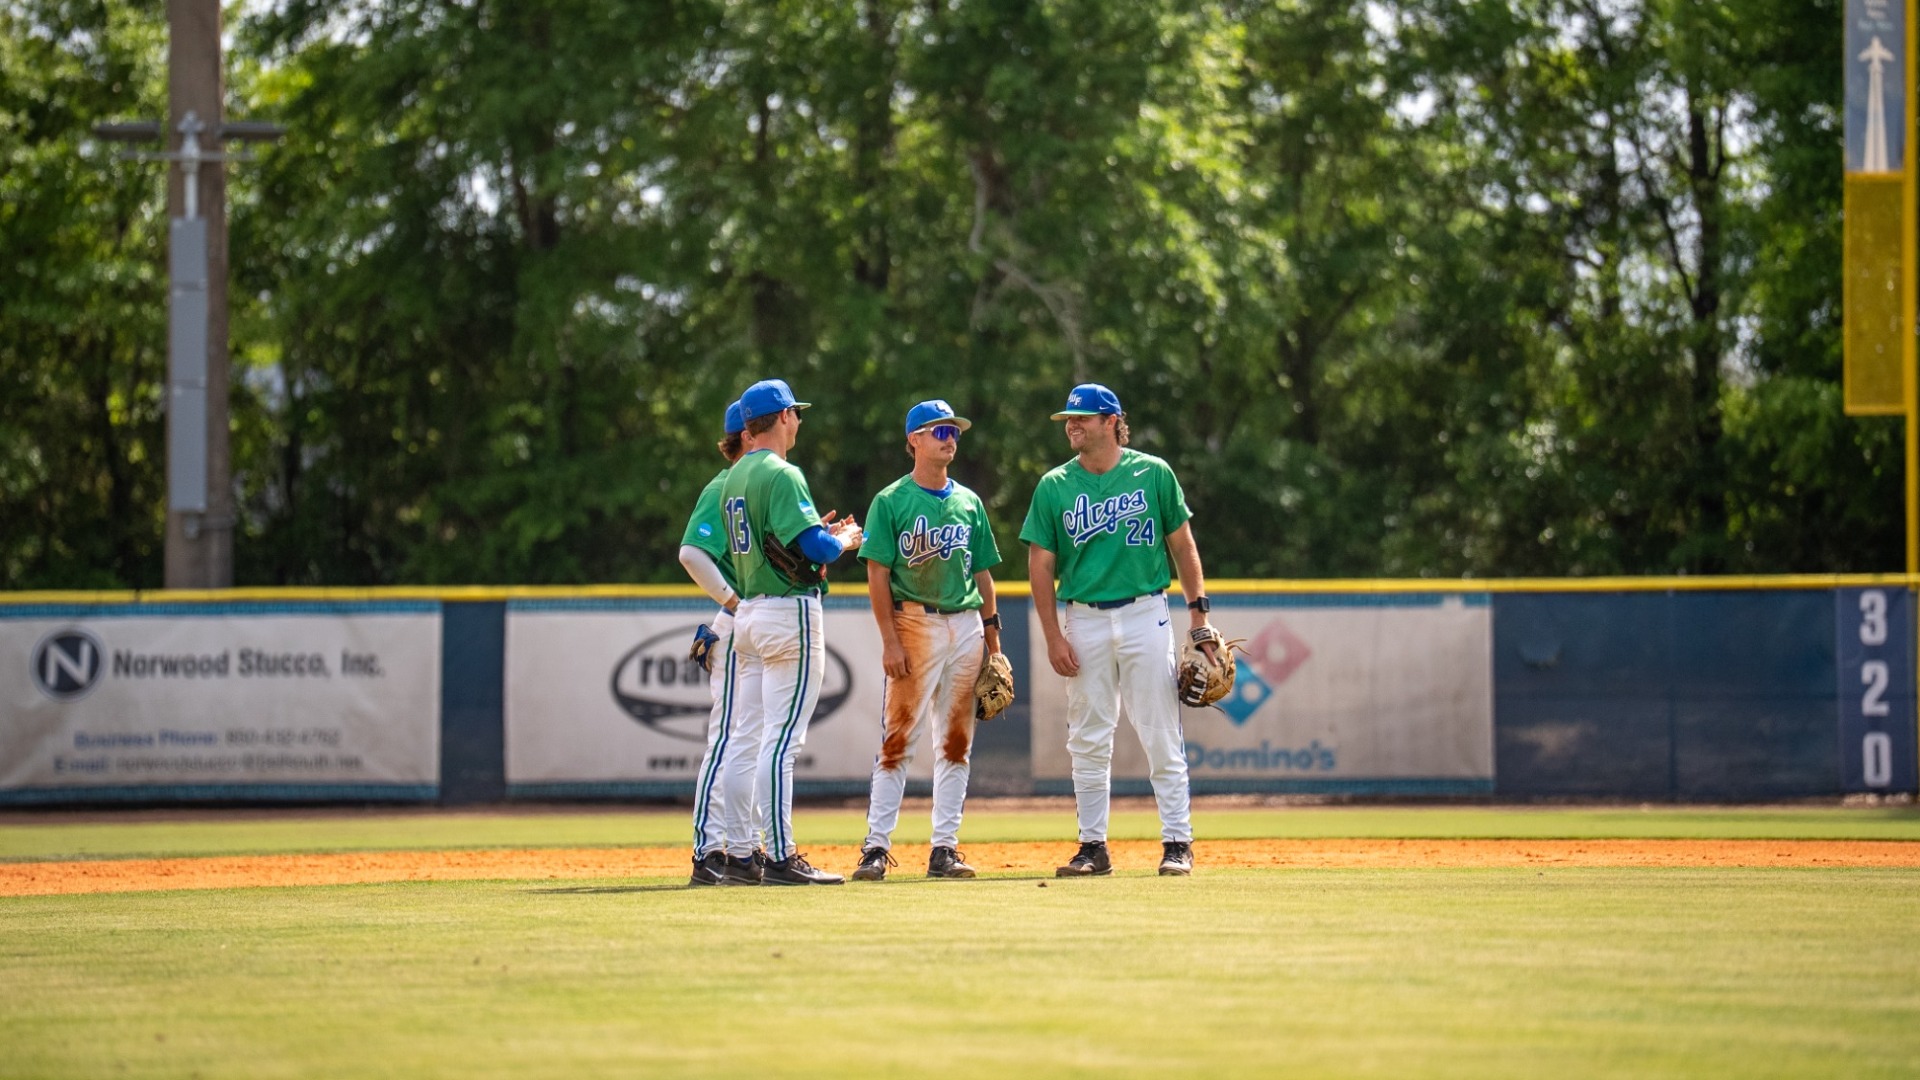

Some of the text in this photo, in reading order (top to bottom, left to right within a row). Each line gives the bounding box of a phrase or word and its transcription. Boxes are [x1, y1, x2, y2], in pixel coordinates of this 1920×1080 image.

[725, 497, 752, 555] 13
[1063, 489, 1148, 548] Argos
[1125, 518, 1155, 546] 24
[113, 648, 385, 682] Norwood Stucco, Inc.
[1186, 740, 1336, 770] Domino's
